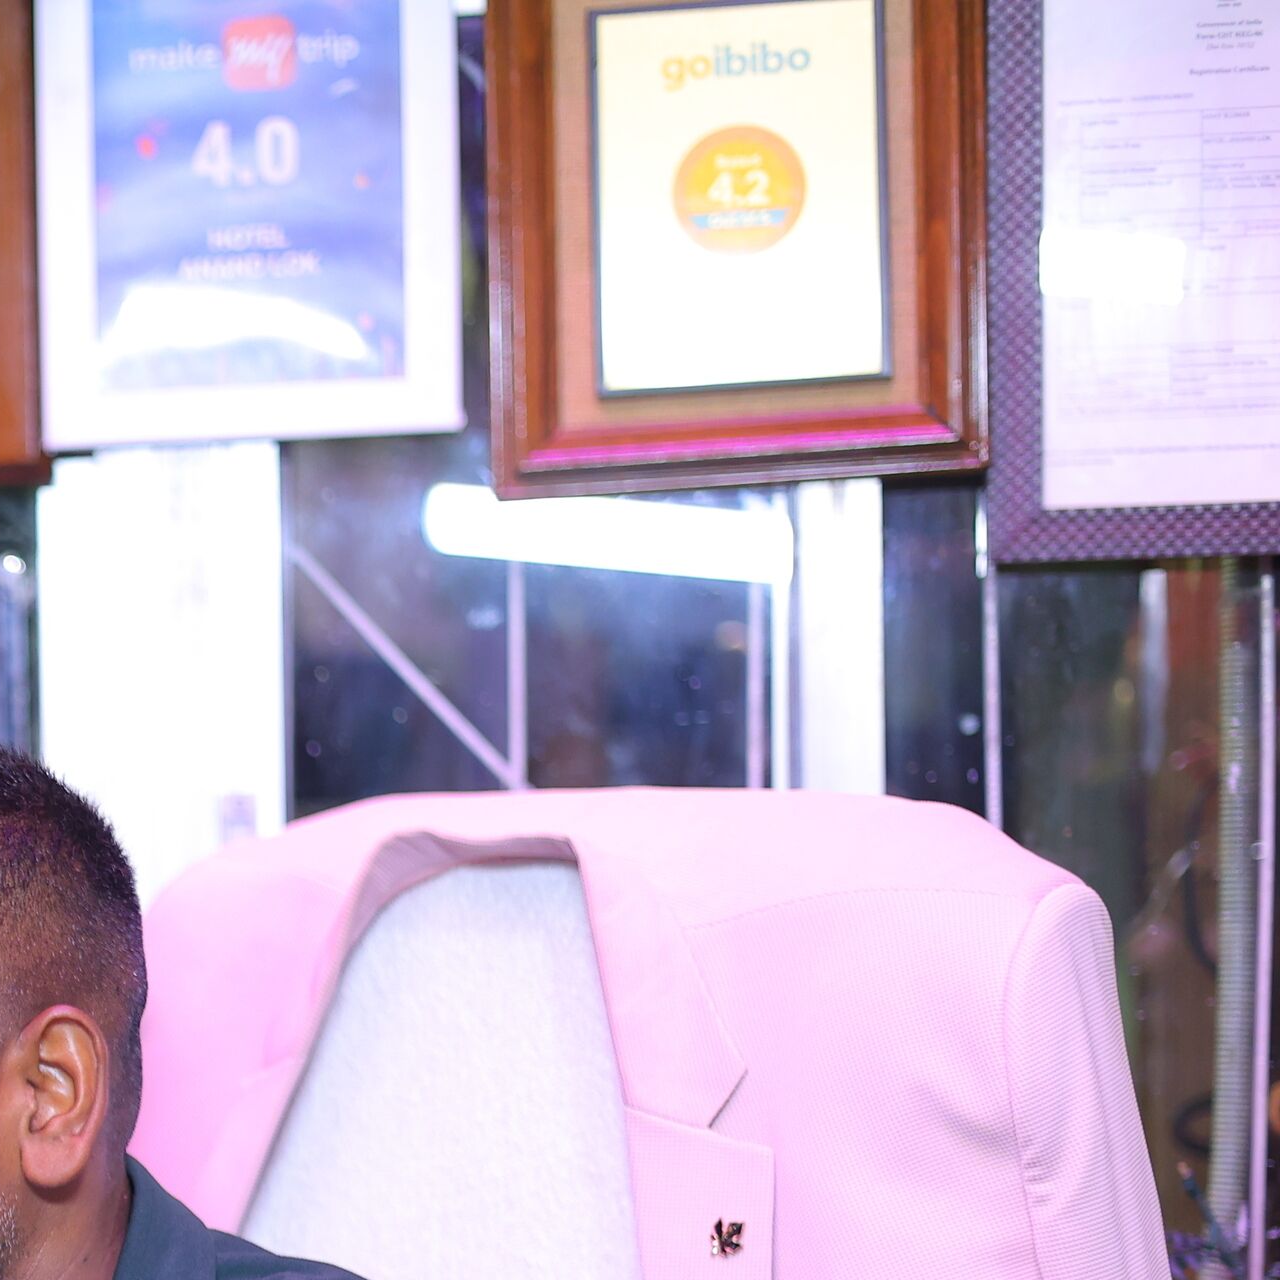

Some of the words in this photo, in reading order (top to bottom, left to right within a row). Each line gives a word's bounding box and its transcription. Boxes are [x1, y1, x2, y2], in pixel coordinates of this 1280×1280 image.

[128, 39, 219, 72] make
[228, 31, 292, 84] my
[296, 29, 361, 69] trip
[660, 41, 812, 93] goibibo
[191, 115, 301, 188] 4.0
[706, 168, 772, 208] 4.2
